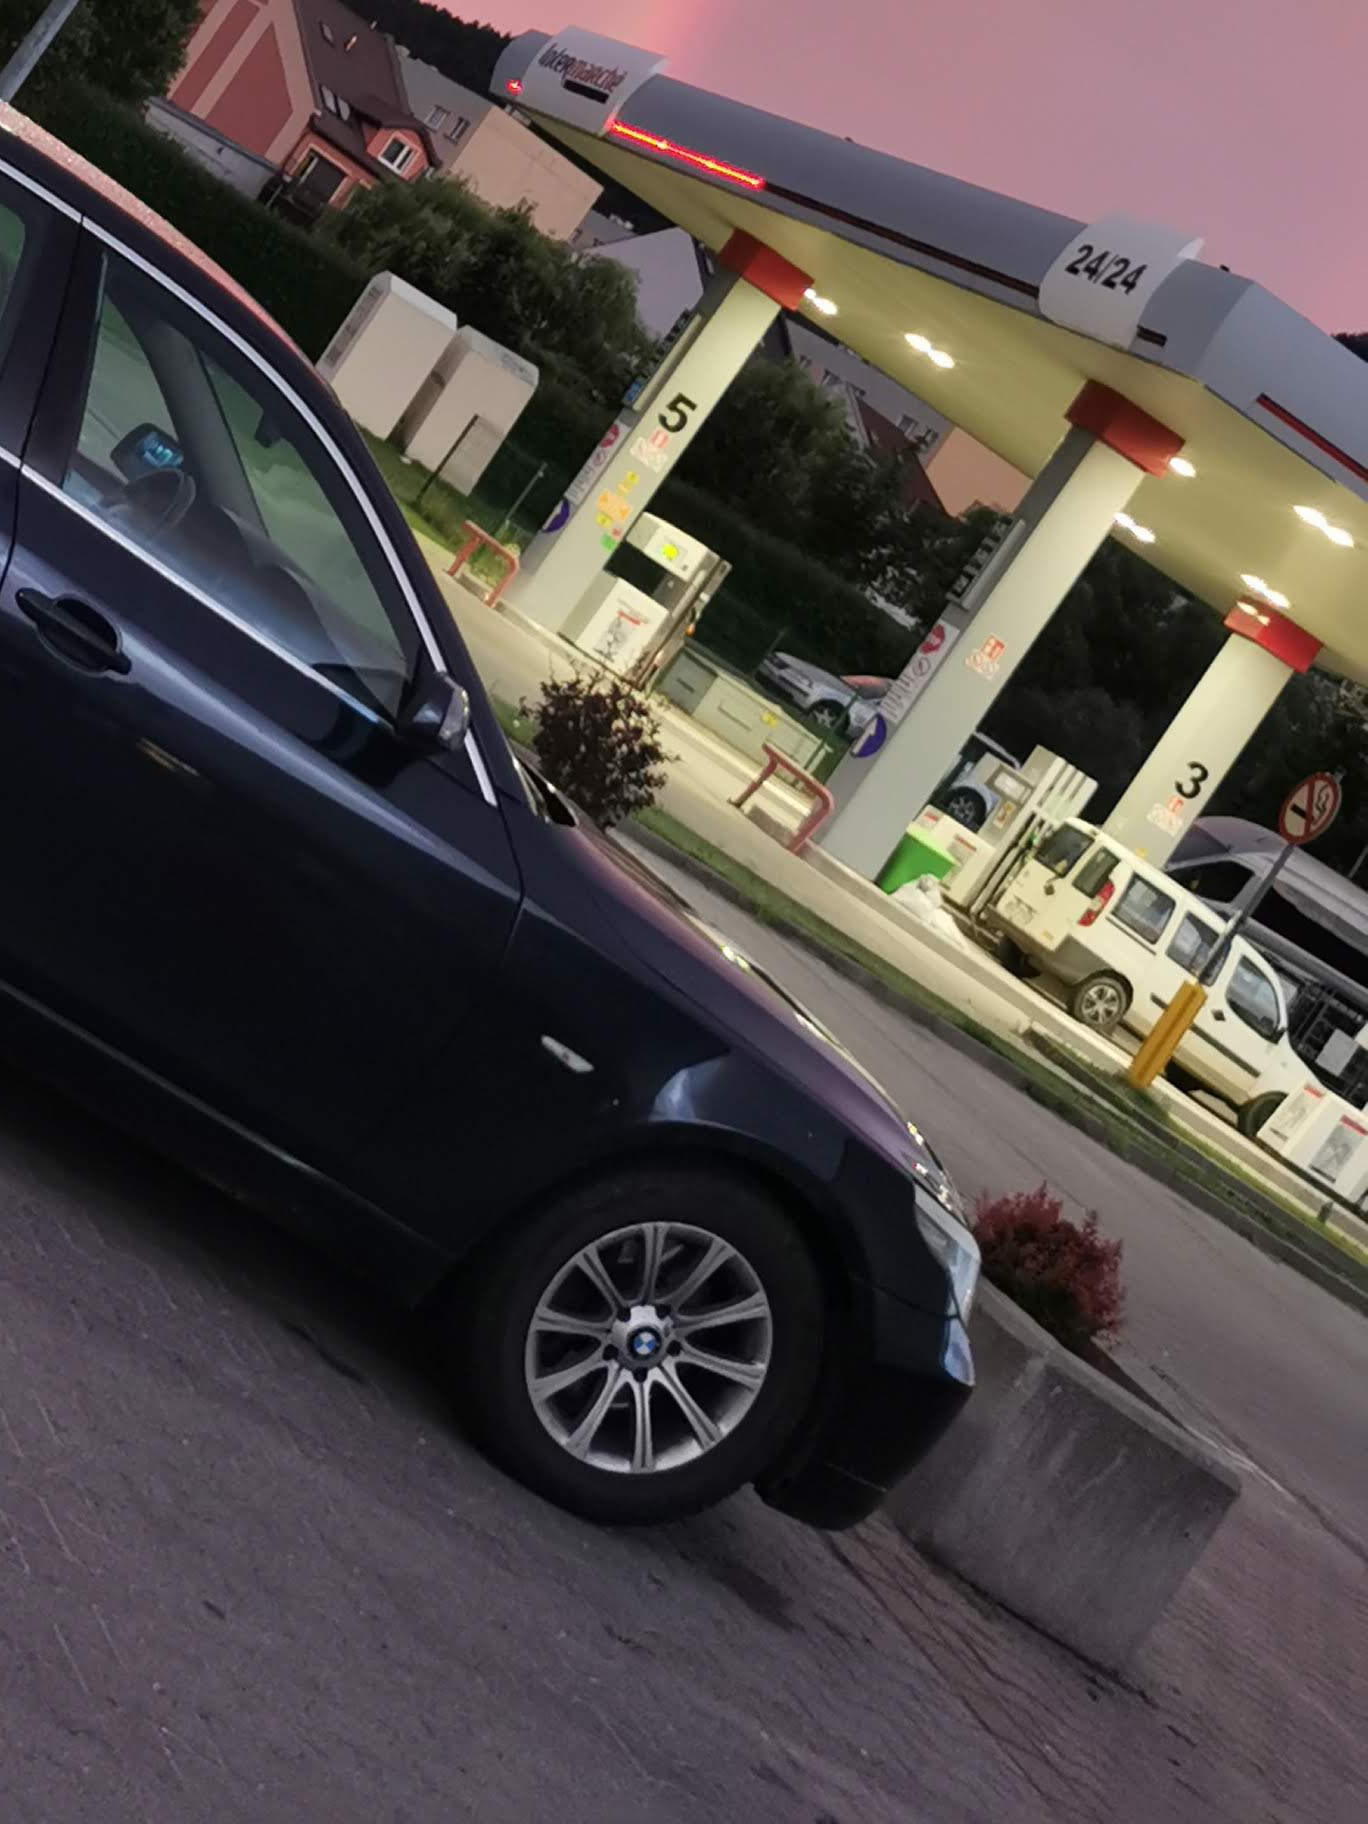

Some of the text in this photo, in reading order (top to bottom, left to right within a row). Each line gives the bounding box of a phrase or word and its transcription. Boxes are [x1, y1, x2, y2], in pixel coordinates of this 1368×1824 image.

[1065, 244, 1148, 295] 24/24
[659, 392, 697, 433] 5
[1175, 761, 1209, 799] 3
